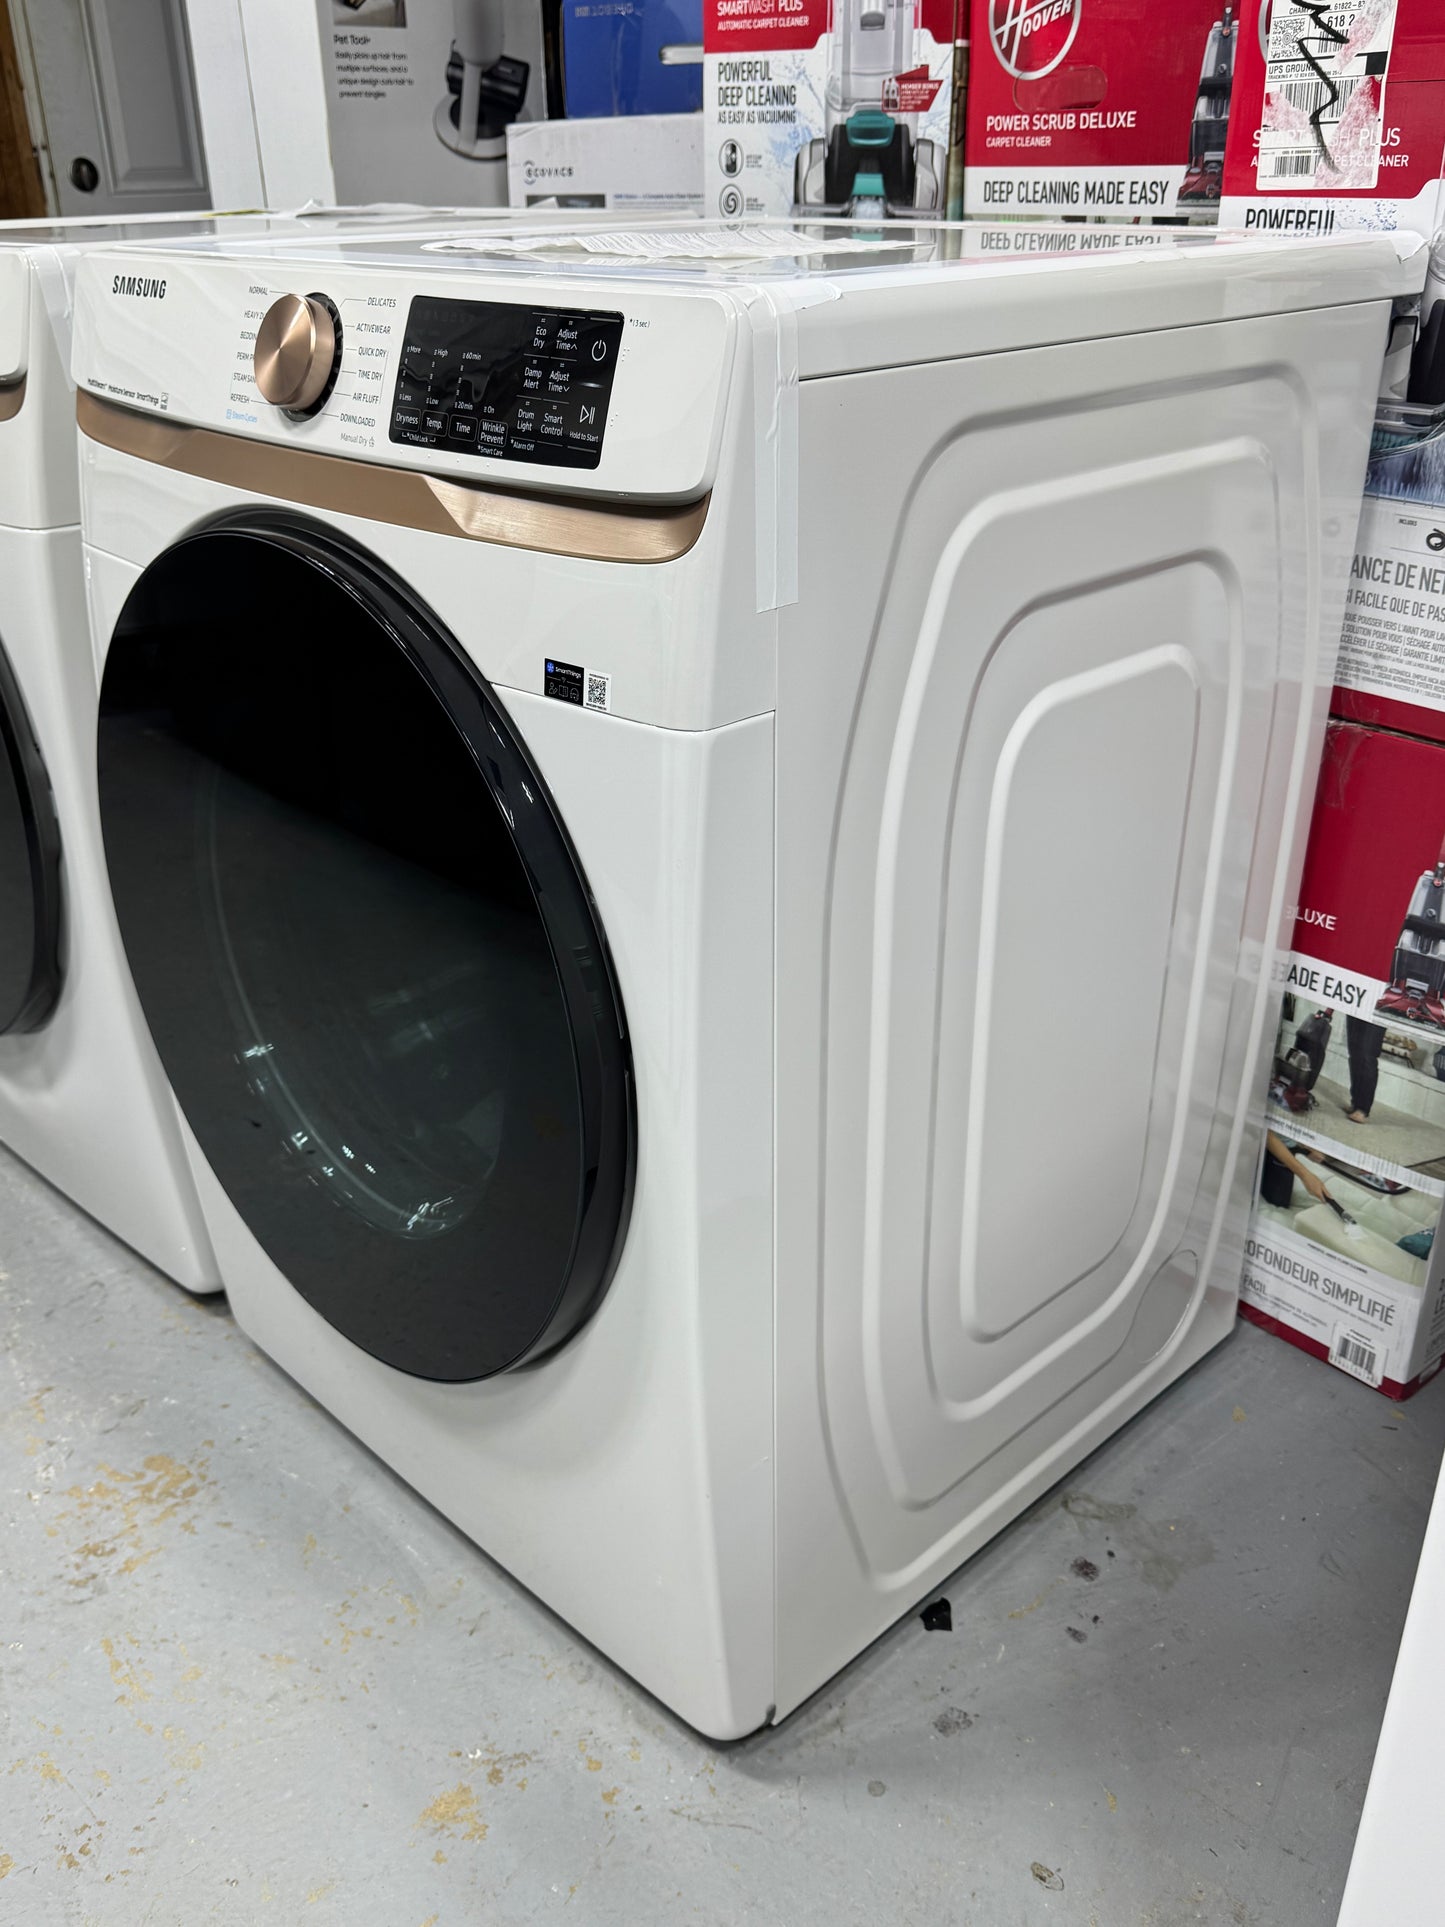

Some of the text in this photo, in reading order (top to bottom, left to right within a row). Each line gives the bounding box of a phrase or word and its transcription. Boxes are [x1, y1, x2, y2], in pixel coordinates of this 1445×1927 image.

[718, 16, 809, 31] AUTOMATIC CARPET CLEANER
[718, 61, 772, 82] POWERFUL
[1268, 64, 1283, 75] UPS
[718, 85, 797, 106] DEEP CLEANING
[718, 111, 726, 124] AS
[728, 111, 745, 124] EASY
[747, 111, 755, 124] AS
[986, 111, 1137, 132] POWER SCRUB DELUXE
[986, 136, 1052, 147] CARPET CLEANER
[983, 180, 1169, 205] DEEP CLEANING MADE EASY
[112, 275, 167, 299] SAMSUNG
[249, 286, 268, 295] NORMAL
[367, 297, 397, 308] DELICATES
[244, 310, 258, 319] HEAVY
[356, 323, 391, 334] ACTIVEWEAR
[536, 327, 547, 336] Eco
[557, 328, 578, 340] Adjust
[533, 338, 544, 349] Dry
[556, 341, 571, 351] Time
[237, 351, 249, 360] PERM
[358, 346, 387, 357] QUICK DRY
[410, 346, 421, 354] More
[438, 349, 448, 358] High
[466, 352, 473, 360] 60
[233, 372, 247, 382] STEAM
[358, 369, 383, 381] TIME DRY
[524, 367, 542, 379] Damp
[549, 370, 570, 382] Adjust
[523, 379, 539, 389] Alert
[548, 382, 563, 393] Time
[231, 393, 250, 403] REFRESH
[353, 392, 379, 404] AIR FLUFF
[402, 393, 412, 401] Less
[458, 401, 473, 411] 20 min
[396, 412, 418, 425] Dryness
[518, 409, 535, 419] Drum
[544, 412, 563, 424] Smart
[340, 413, 375, 427] DOWNLOADED
[426, 418, 443, 429] Temp.
[456, 423, 471, 434] Time
[482, 422, 505, 434] Wrinkle
[517, 421, 533, 432] Light
[541, 424, 563, 436] Control
[341, 433, 368, 447] Manual Dry
[481, 432, 504, 445] Prevent
[570, 431, 580, 439] Hold
[586, 433, 599, 442] Start
[1350, 554, 1393, 584] ANCE
[1394, 562, 1418, 588] DE
[1354, 590, 1388, 610] FACILE
[1389, 597, 1410, 615] QUE
[1411, 601, 1426, 618] DE
[1383, 621, 1397, 631] VERS
[1287, 964, 1367, 1008] ADE EASY
[1322, 1277, 1396, 1327] SIMPLIFIÉ
